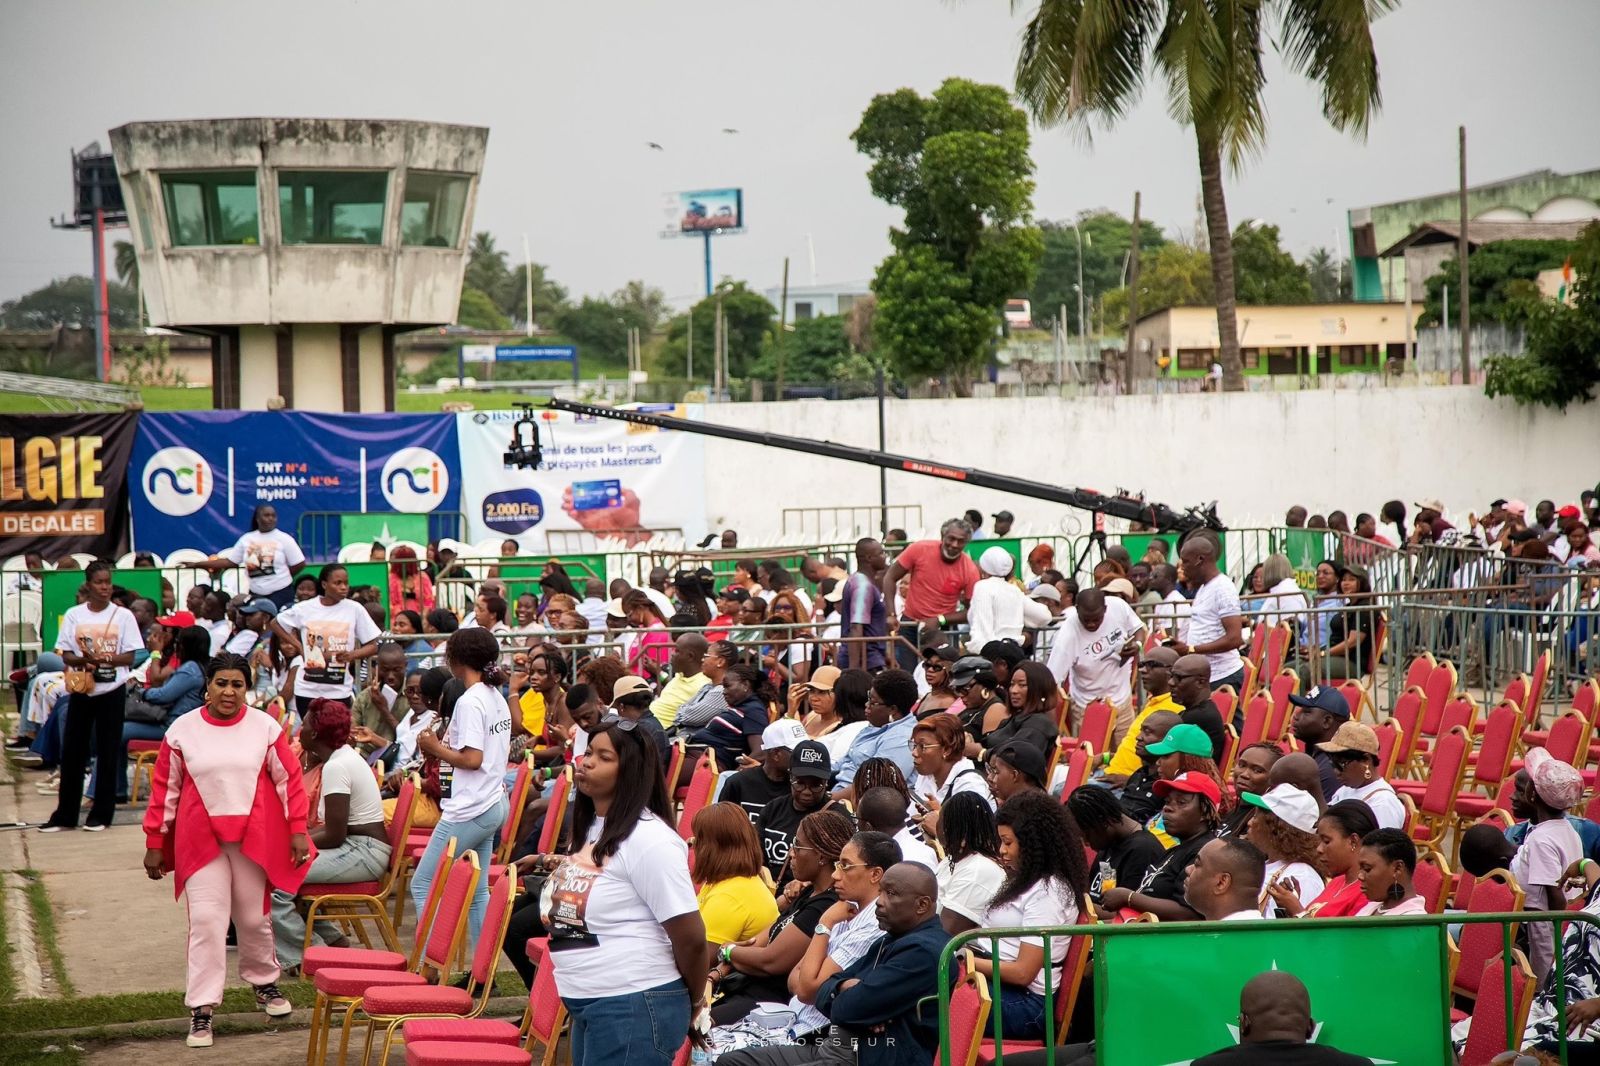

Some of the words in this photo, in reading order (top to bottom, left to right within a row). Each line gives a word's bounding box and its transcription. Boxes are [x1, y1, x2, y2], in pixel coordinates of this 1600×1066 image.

[601, 454, 662, 466] Mastercard
[256, 462, 283, 473] TNT
[256, 475, 307, 487] CANAL+
[3, 513, 97, 533] DÉCALÉE
[764, 837, 794, 861] RG
